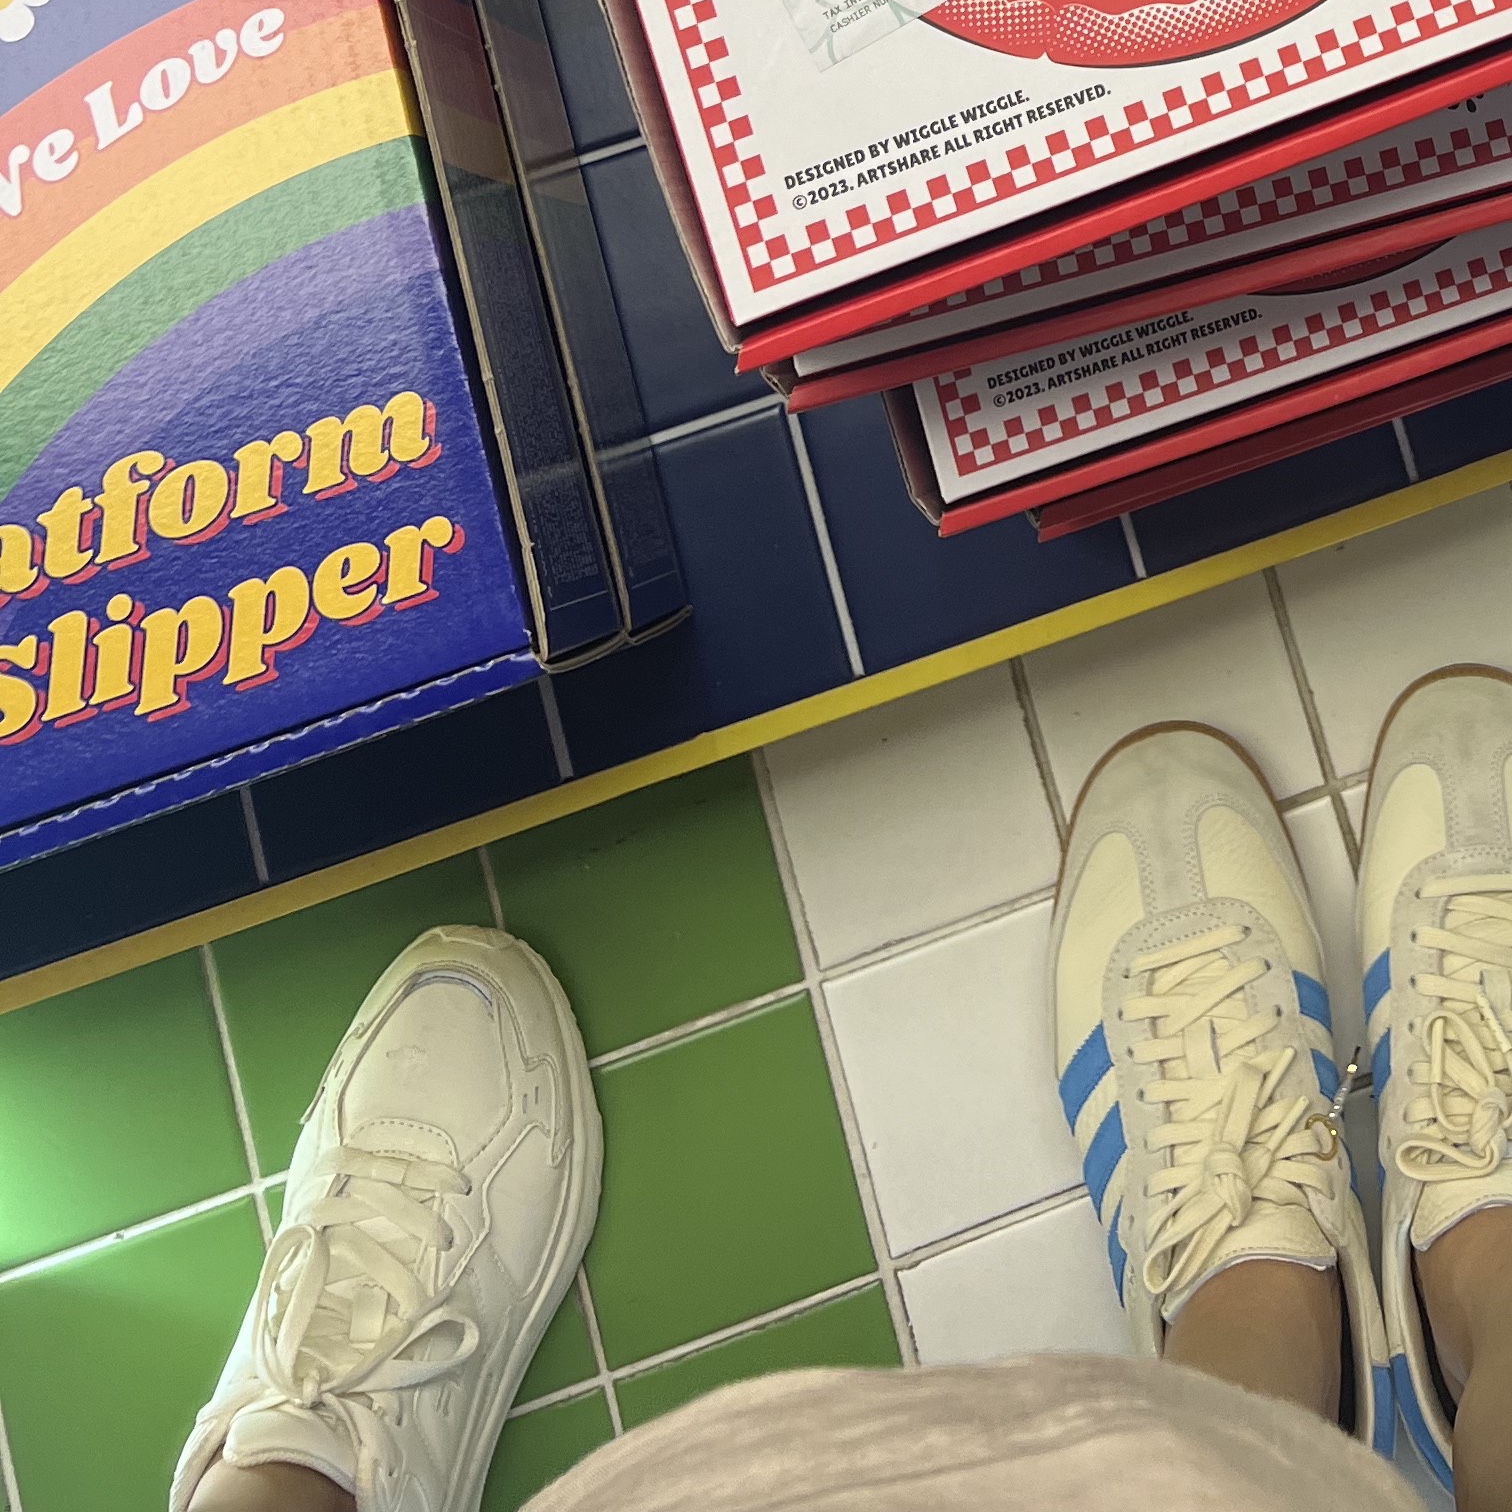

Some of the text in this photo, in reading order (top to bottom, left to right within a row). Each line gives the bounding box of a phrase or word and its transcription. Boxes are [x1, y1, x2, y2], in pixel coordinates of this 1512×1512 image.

[823, 5, 842, 19] TAX
[830, 5, 872, 32] CASHIER
[84, 8, 285, 150] Love
[784, 89, 1030, 189] DESIGNED BY WIGGLE WIGGLE.
[792, 83, 1111, 210] ©2023. ARTSHARE ALL RIGHT RESERVED.
[987, 311, 1194, 389] DESIGNED BY WIGGLE WIGGLE.
[1047, 356, 1118, 390] ARTSHARE
[1120, 347, 1145, 365] ALL
[1146, 331, 1188, 355] RIGHT
[1190, 307, 1262, 340] RESERVED.
